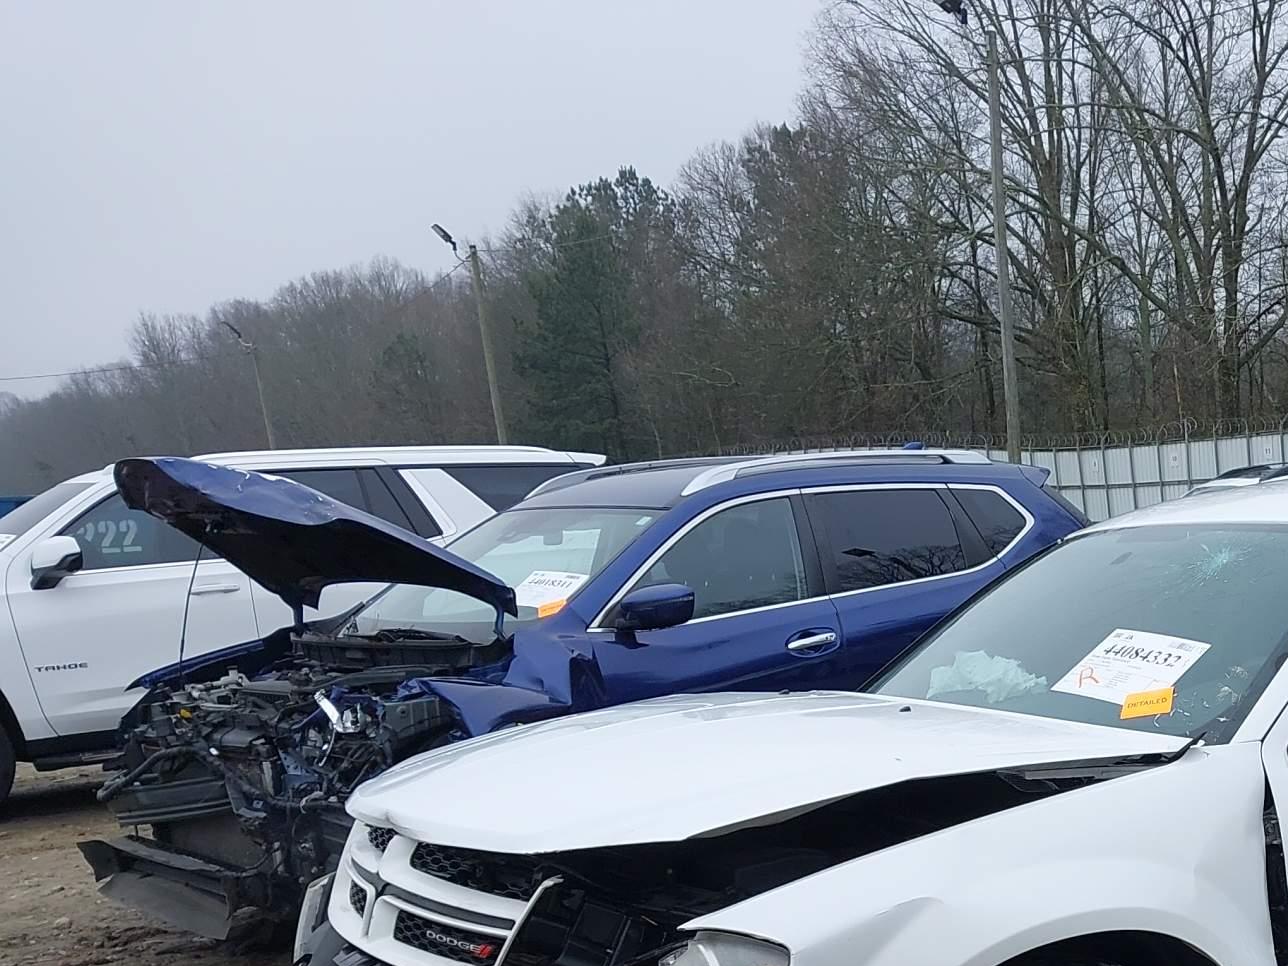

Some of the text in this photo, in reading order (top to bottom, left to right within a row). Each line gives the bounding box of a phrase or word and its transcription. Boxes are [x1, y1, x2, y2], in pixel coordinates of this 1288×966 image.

[1104, 643, 1181, 667] 44084332
[34, 662, 88, 673] TAHOE
[1127, 696, 1168, 709] DETAILED
[426, 930, 482, 954] DODGE
